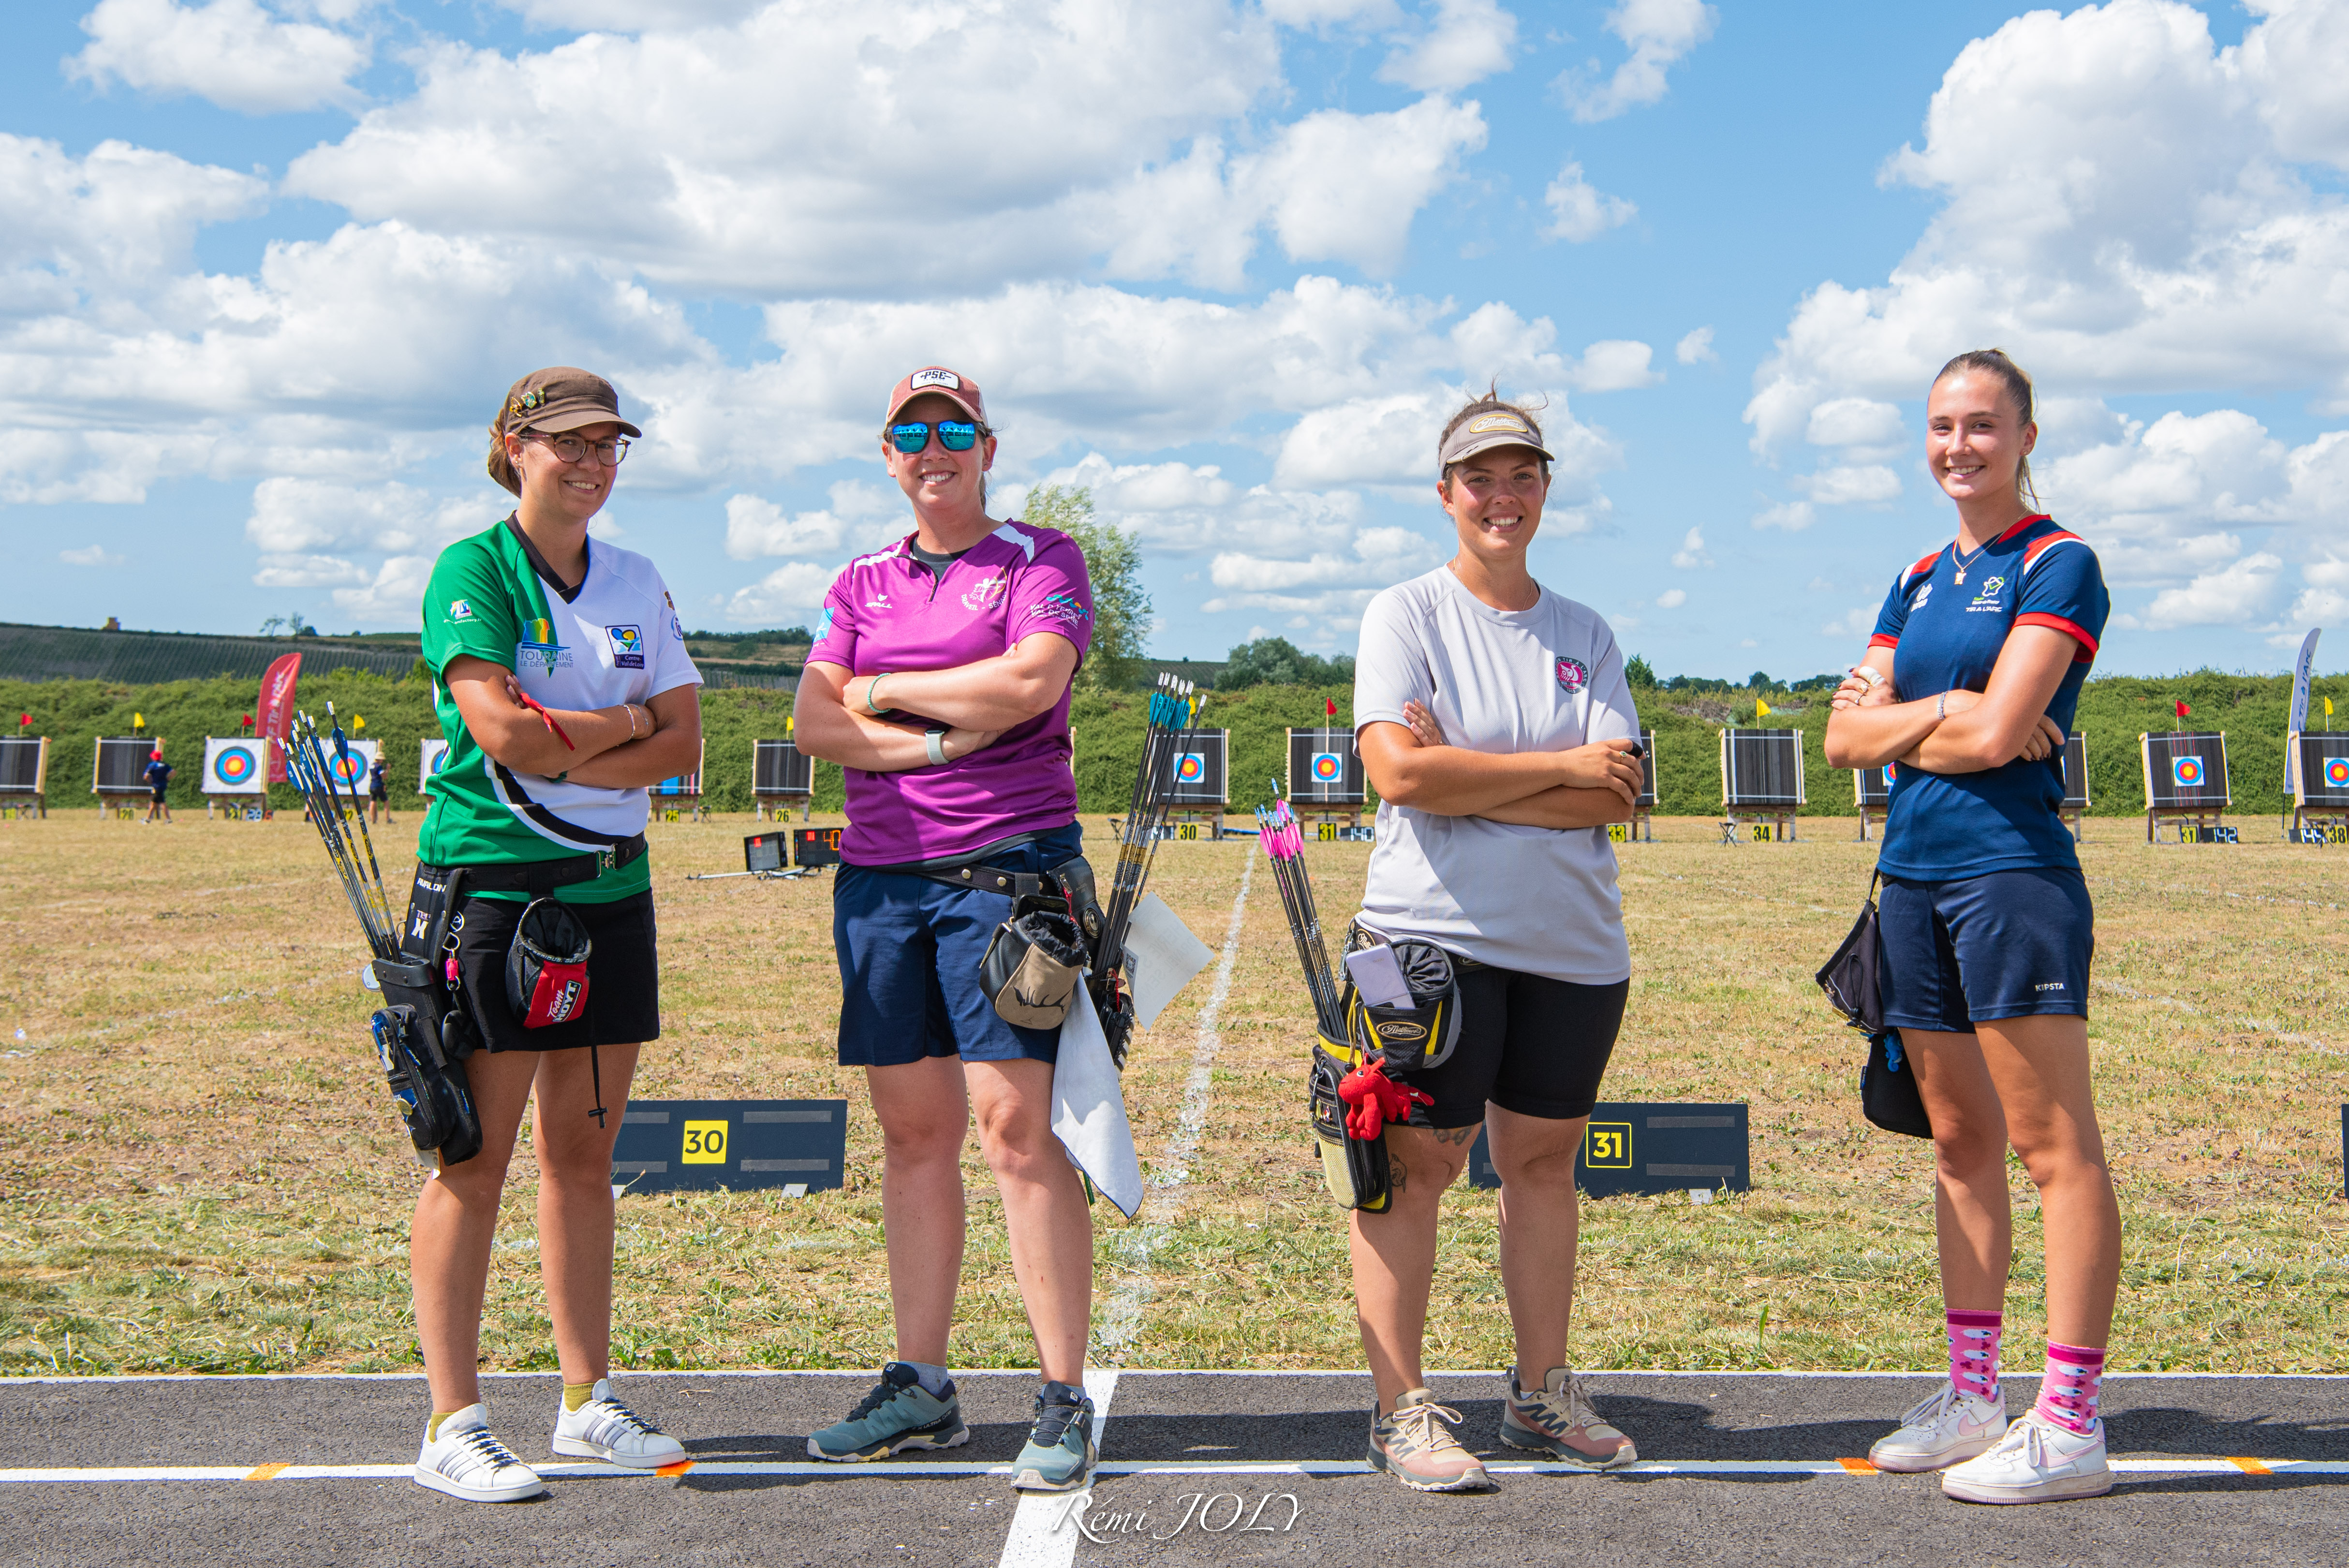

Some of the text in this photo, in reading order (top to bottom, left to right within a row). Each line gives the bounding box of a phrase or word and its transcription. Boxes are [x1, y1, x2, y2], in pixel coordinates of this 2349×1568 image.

[924, 370, 946, 380] PSE
[1475, 417, 1524, 431] Mathews
[961, 593, 978, 610] DRAVEIL
[520, 651, 573, 662] TOURAINE
[666, 810, 680, 822] 25
[777, 810, 789, 822] 26
[1180, 825, 1197, 840] 30
[1319, 823, 1335, 841] 31
[1350, 826, 1374, 842] 140
[1608, 825, 1625, 843] 33
[1754, 826, 1770, 843] 34
[2182, 827, 2197, 843] 37
[2213, 827, 2238, 844] 142
[2300, 828, 2327, 843] 144
[2329, 827, 2346, 843] 38
[416, 877, 447, 892] AVALON
[2035, 983, 2065, 992] KIPSTA
[547, 989, 564, 1017] Team
[555, 982, 577, 1021] HOYT
[1381, 1024, 1422, 1035] Mathews
[685, 1130, 724, 1154] 30
[1593, 1132, 1622, 1158] 31
[923, 1419, 942, 1429] ULTRA
